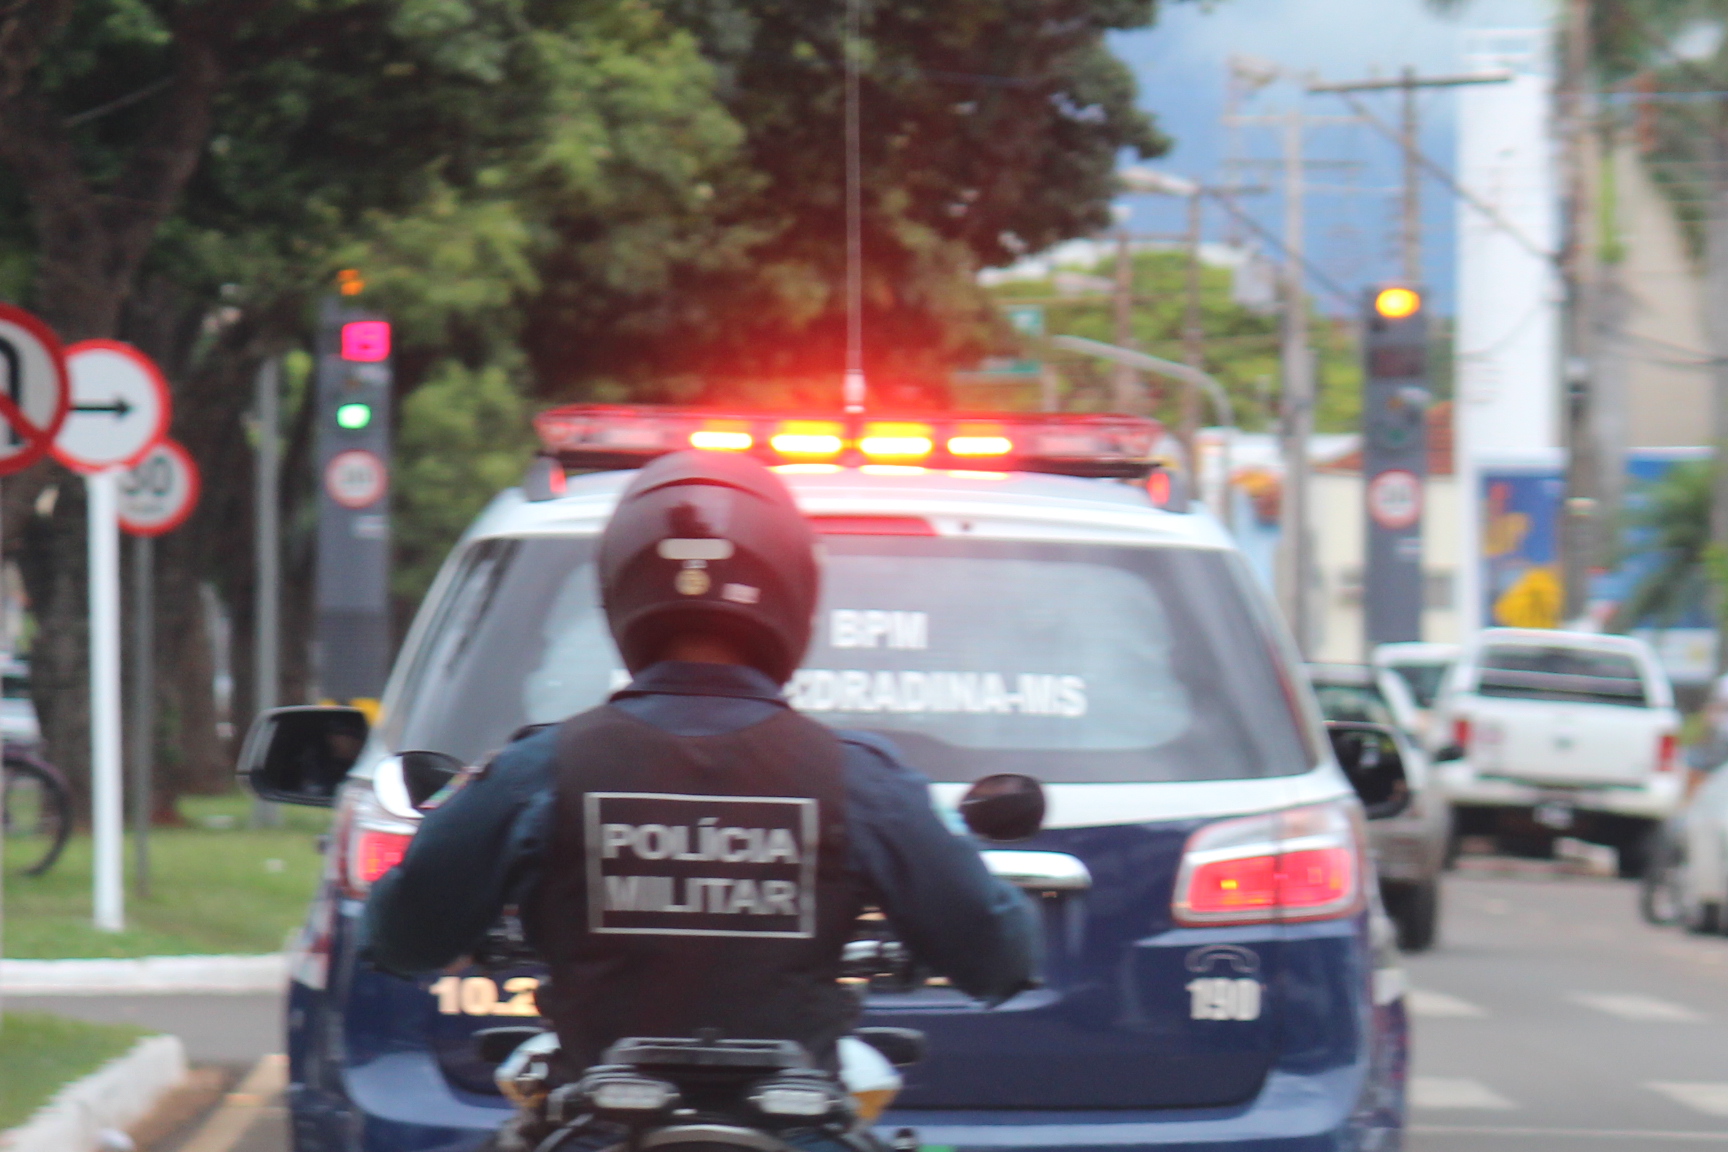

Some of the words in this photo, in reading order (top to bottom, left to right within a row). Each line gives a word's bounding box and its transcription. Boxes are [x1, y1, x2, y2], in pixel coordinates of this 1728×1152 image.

[831, 608, 928, 649] BPM
[601, 816, 801, 864] POLÍCIA
[604, 875, 800, 916] MILITAR
[1184, 976, 1262, 1021] 190
